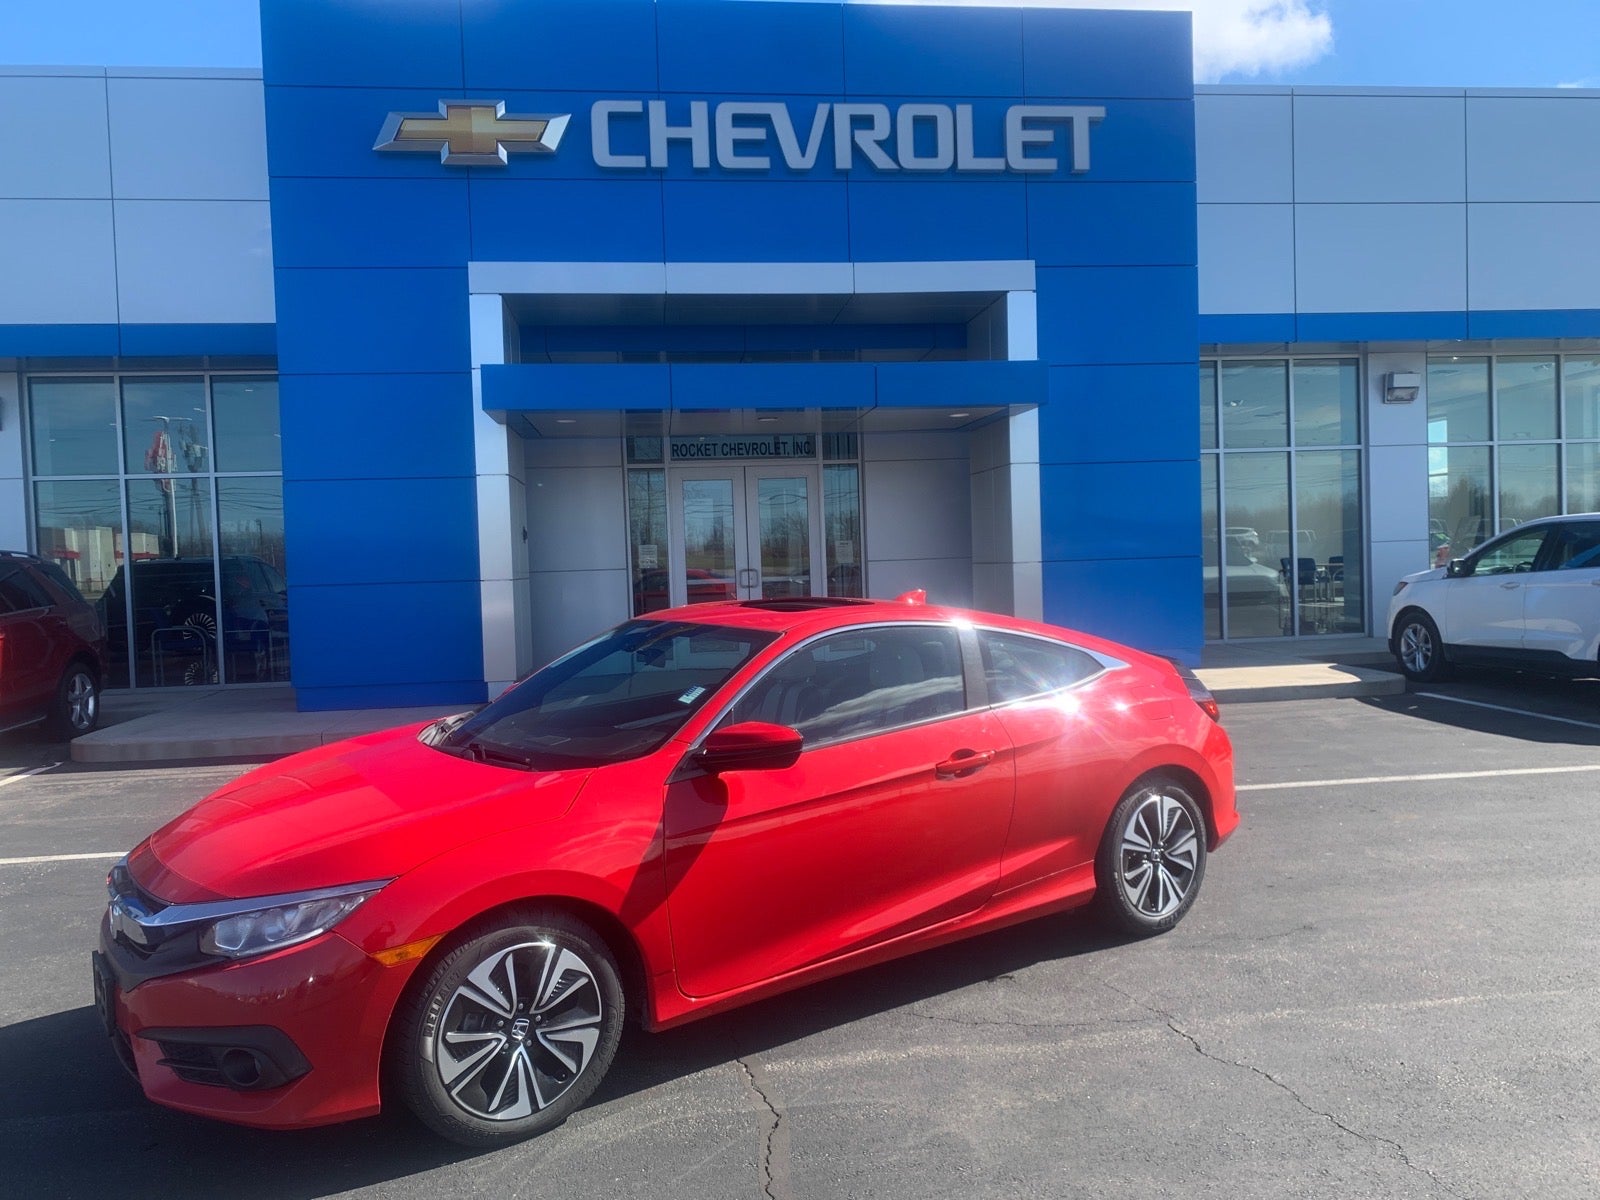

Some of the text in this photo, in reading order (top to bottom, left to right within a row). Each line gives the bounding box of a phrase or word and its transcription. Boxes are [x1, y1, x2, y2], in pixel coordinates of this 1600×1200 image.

[591, 99, 1106, 173] CHEVROLET
[671, 443, 719, 457] ROCKET
[792, 440, 815, 455] INC.
